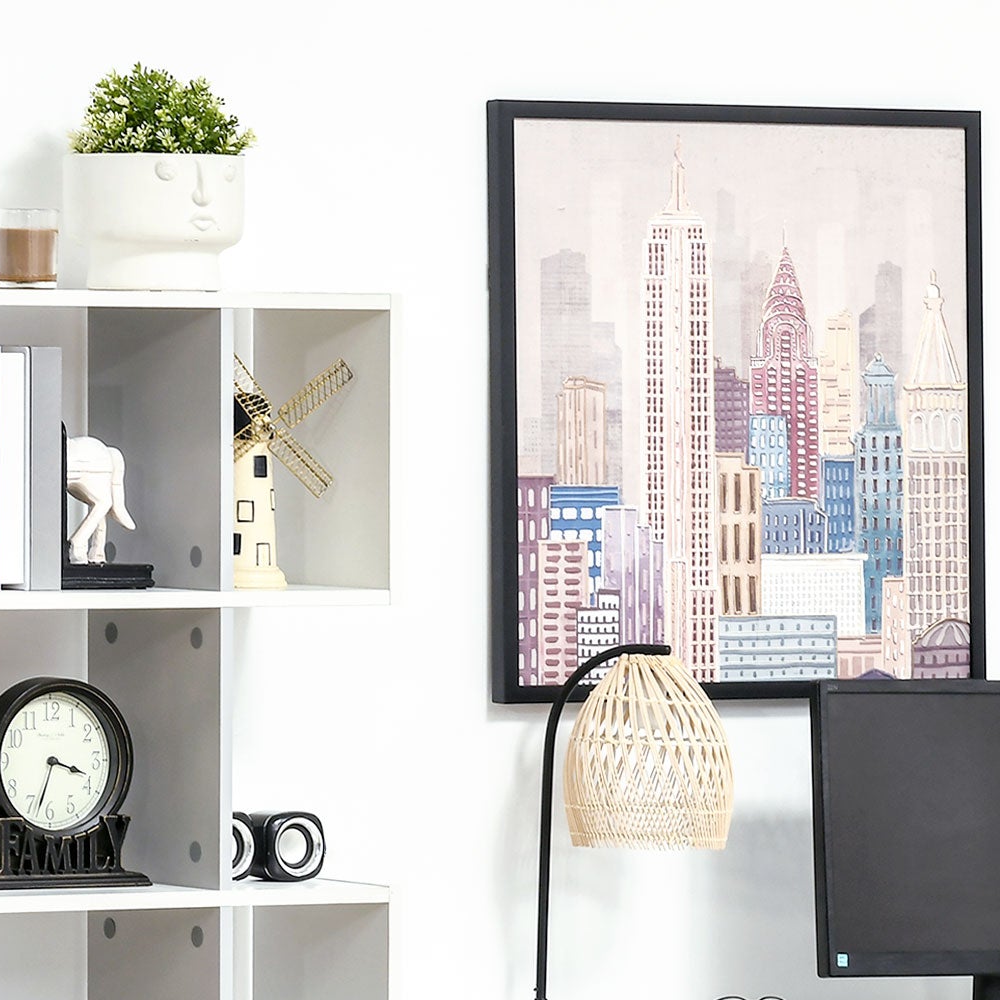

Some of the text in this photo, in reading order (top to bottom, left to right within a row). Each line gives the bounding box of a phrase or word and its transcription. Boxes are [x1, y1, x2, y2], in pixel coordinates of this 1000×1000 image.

[22, 711, 36, 730] 11
[43, 701, 60, 721] 12
[68, 708, 75, 728] 1
[7, 728, 23, 749] 10
[83, 723, 92, 743] 2
[91, 751, 100, 770] 3
[7, 779, 17, 798] 8
[82, 775, 92, 795] 4
[25, 795, 36, 814] 7
[45, 801, 55, 820] 6
[66, 795, 75, 814] 5
